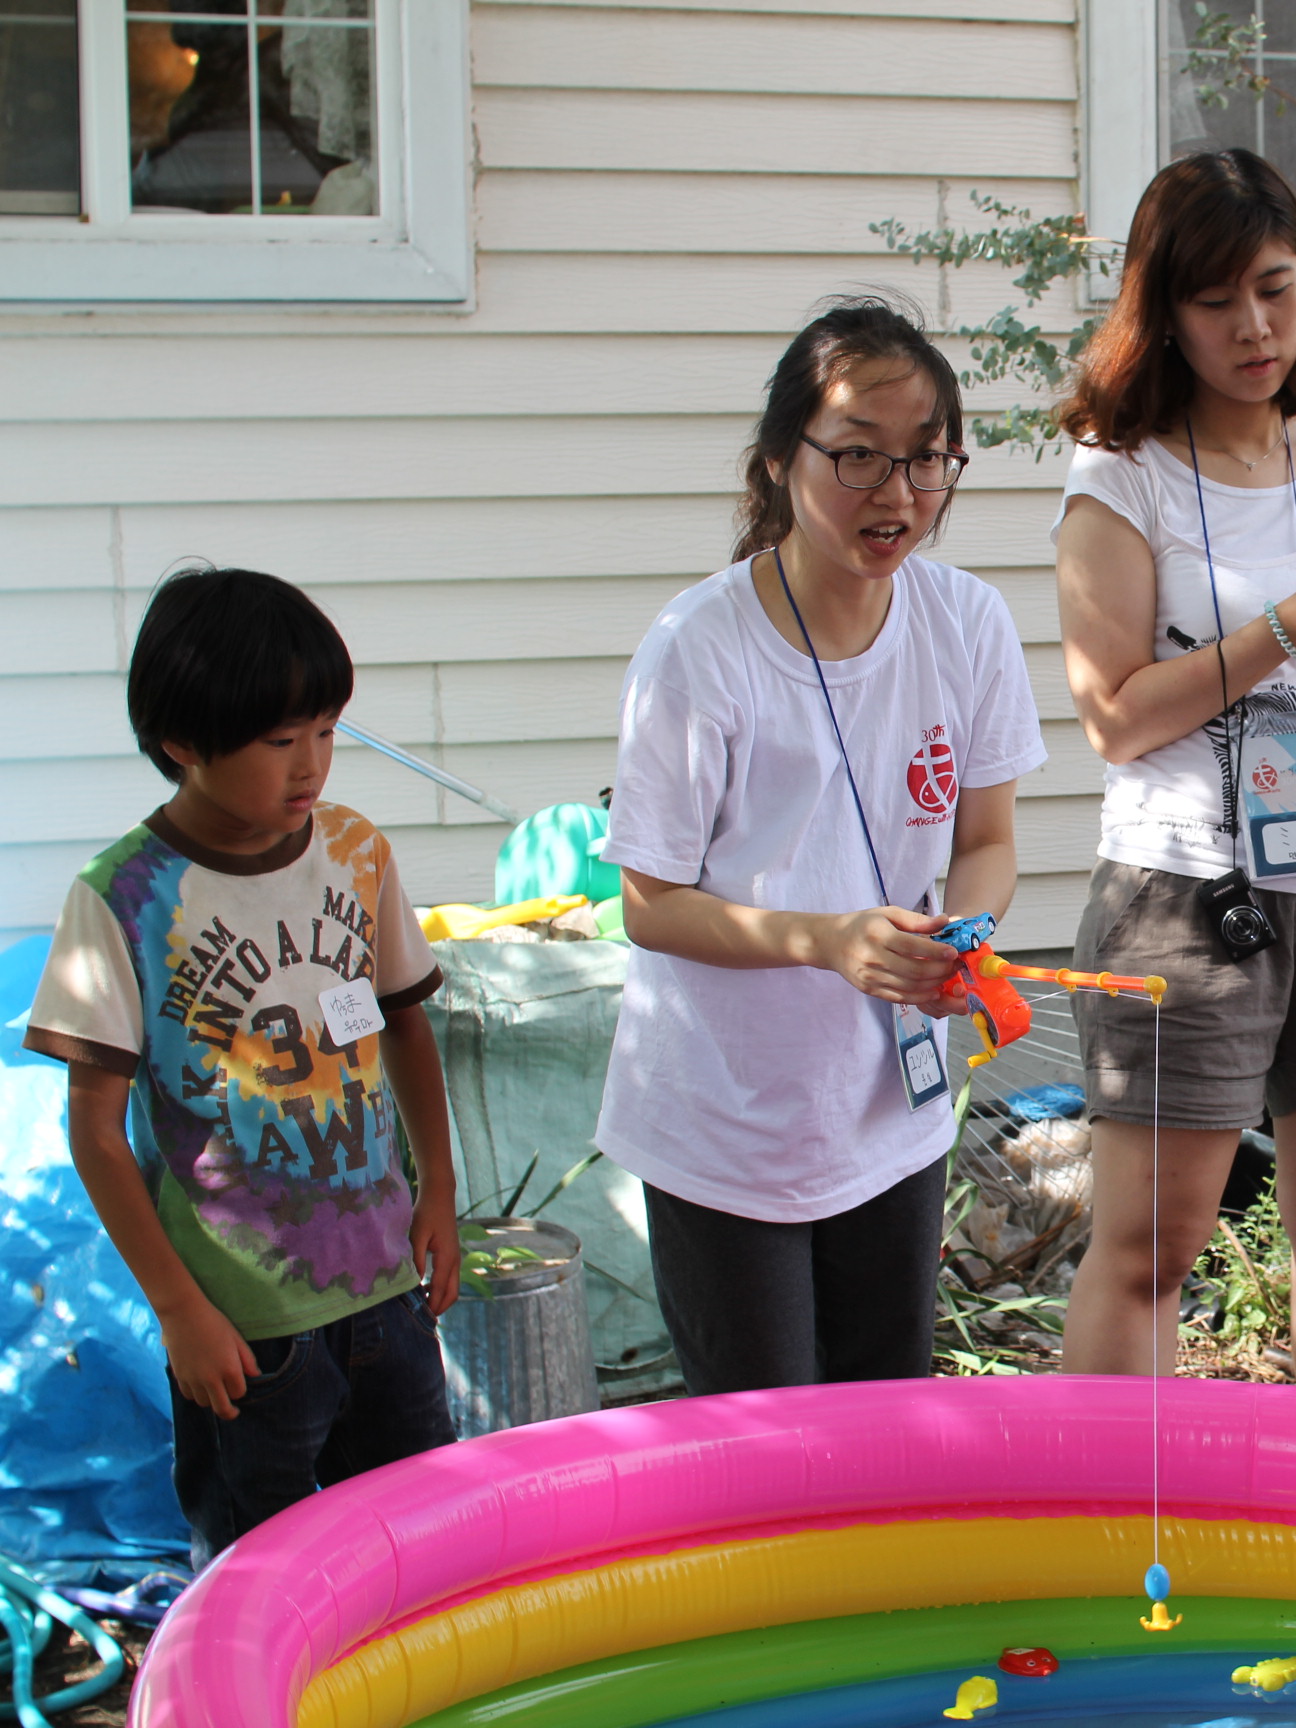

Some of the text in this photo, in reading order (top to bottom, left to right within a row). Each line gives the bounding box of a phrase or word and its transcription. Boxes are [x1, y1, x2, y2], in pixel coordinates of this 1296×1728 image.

[921, 723, 946, 743] 30th
[323, 885, 376, 952] MAK
[158, 915, 237, 1026] DREAM
[186, 938, 272, 1053] INTO
[277, 920, 303, 968] A
